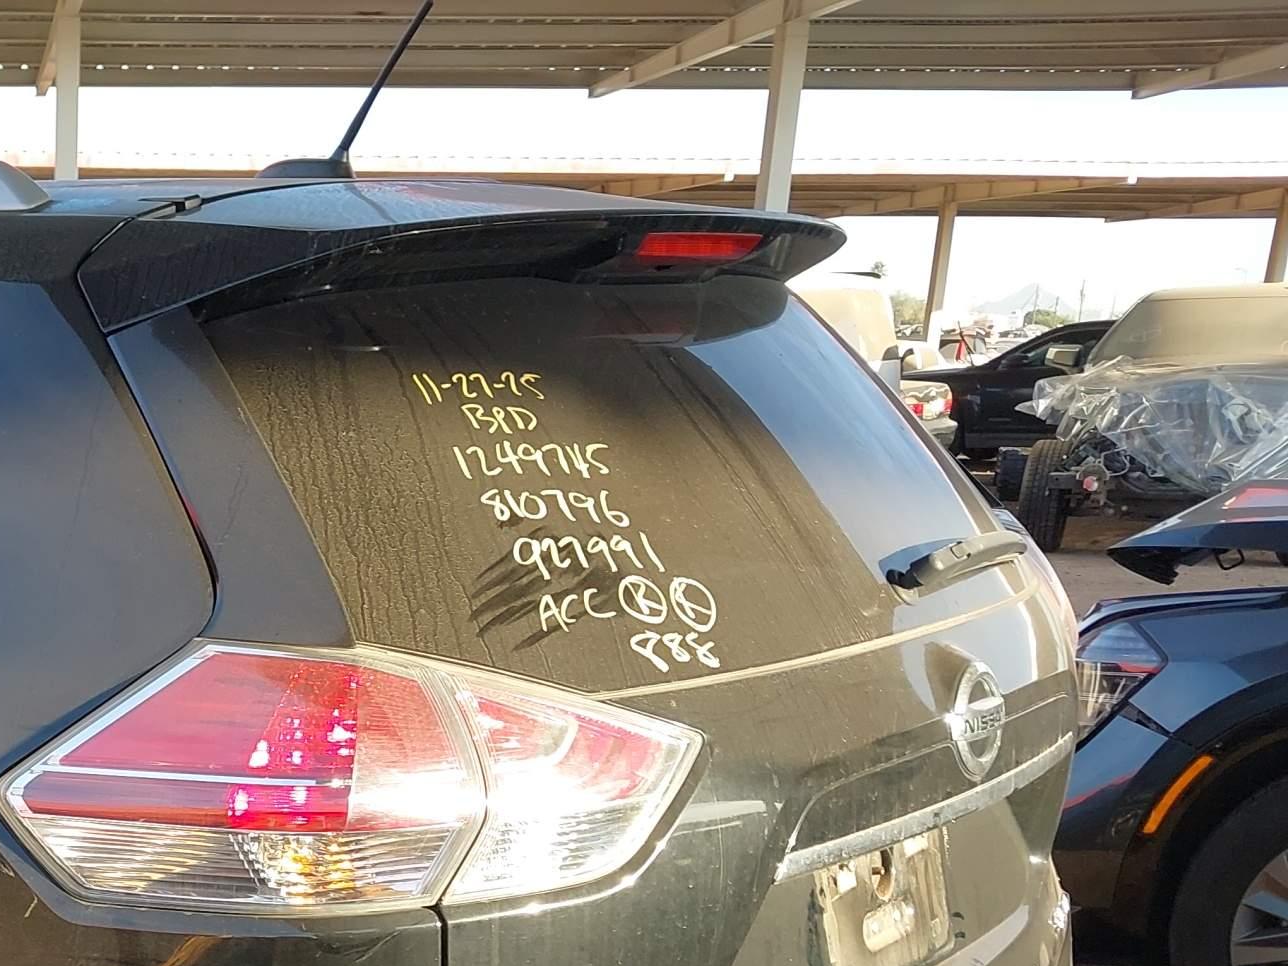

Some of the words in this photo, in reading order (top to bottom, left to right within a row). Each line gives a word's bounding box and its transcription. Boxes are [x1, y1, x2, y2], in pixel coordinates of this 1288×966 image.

[479, 488, 631, 528] 810796
[512, 530, 666, 580] 927991
[538, 587, 617, 633] ACC
[963, 708, 1003, 735] NISSA
